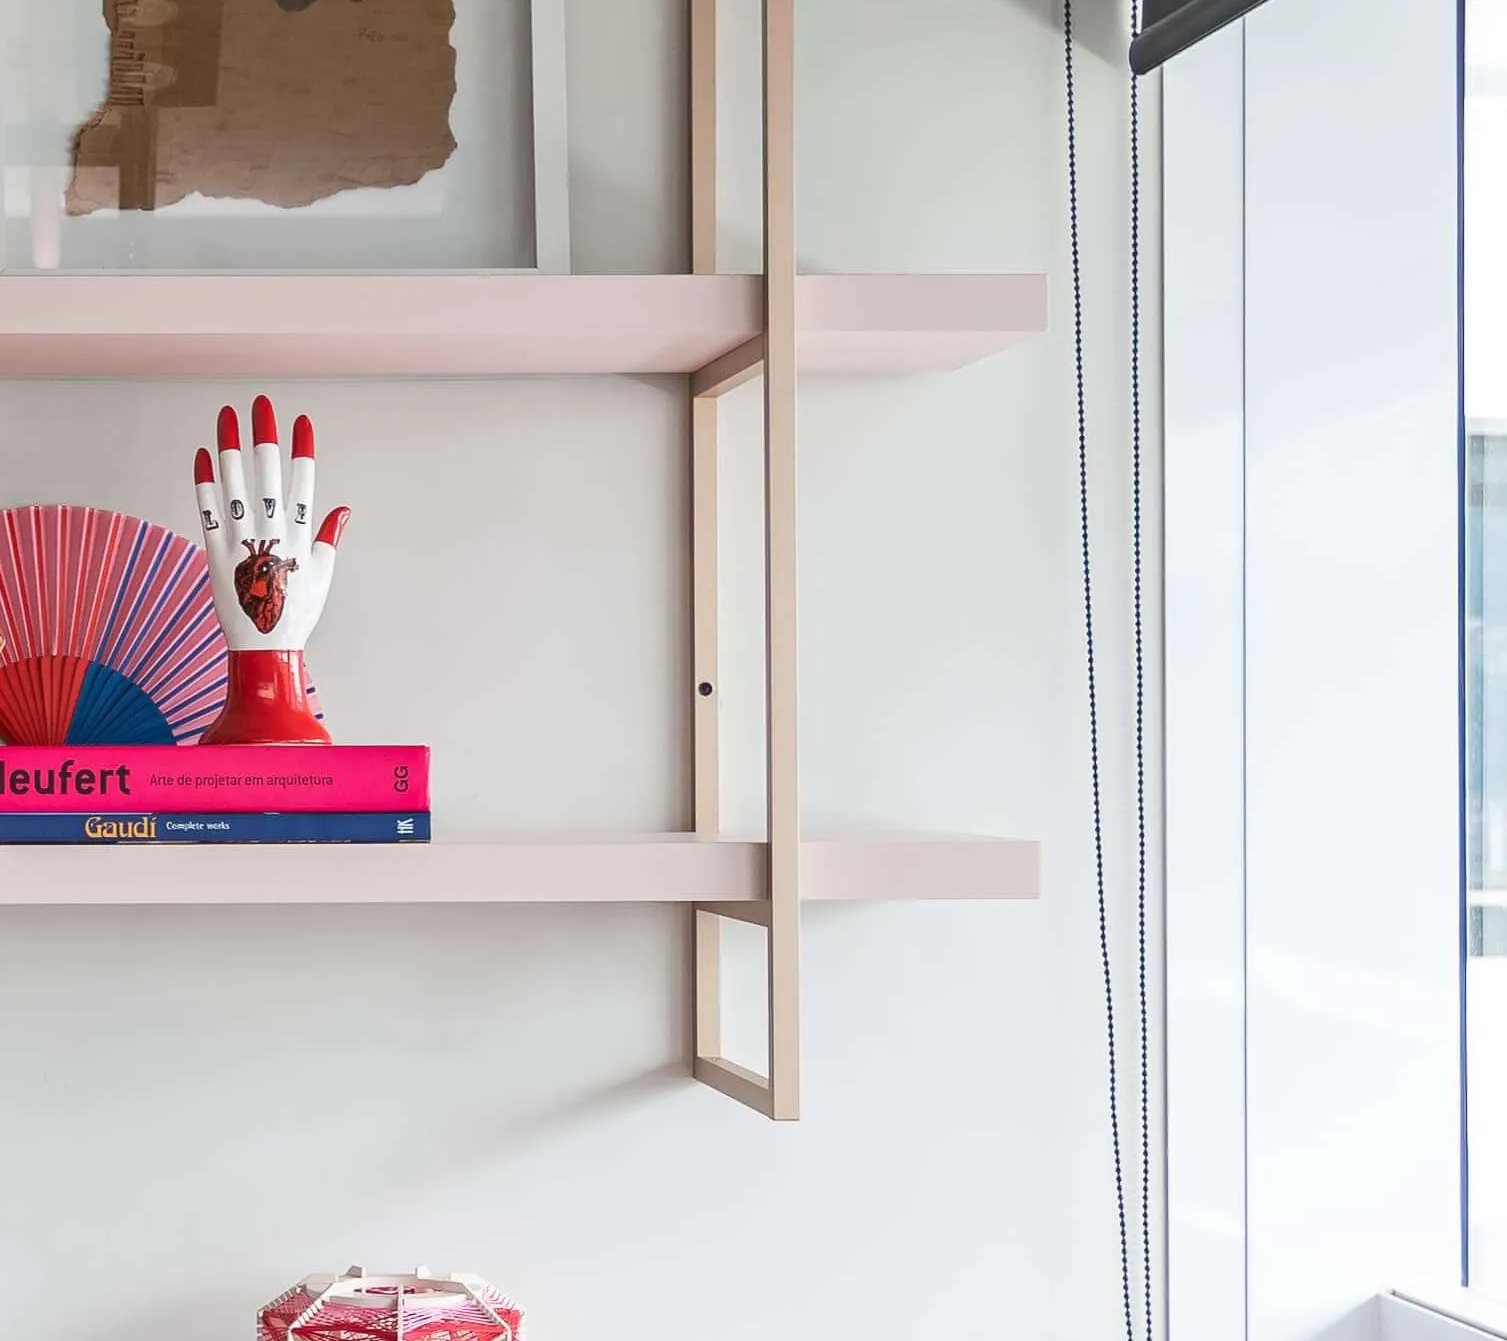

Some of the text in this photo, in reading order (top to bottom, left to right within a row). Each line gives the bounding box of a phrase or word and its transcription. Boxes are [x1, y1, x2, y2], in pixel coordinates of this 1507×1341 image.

[149, 773, 334, 789] Arte de projetar em arquitetura
[393, 765, 409, 793] GG
[84, 815, 231, 839] Gaudí Complete works
